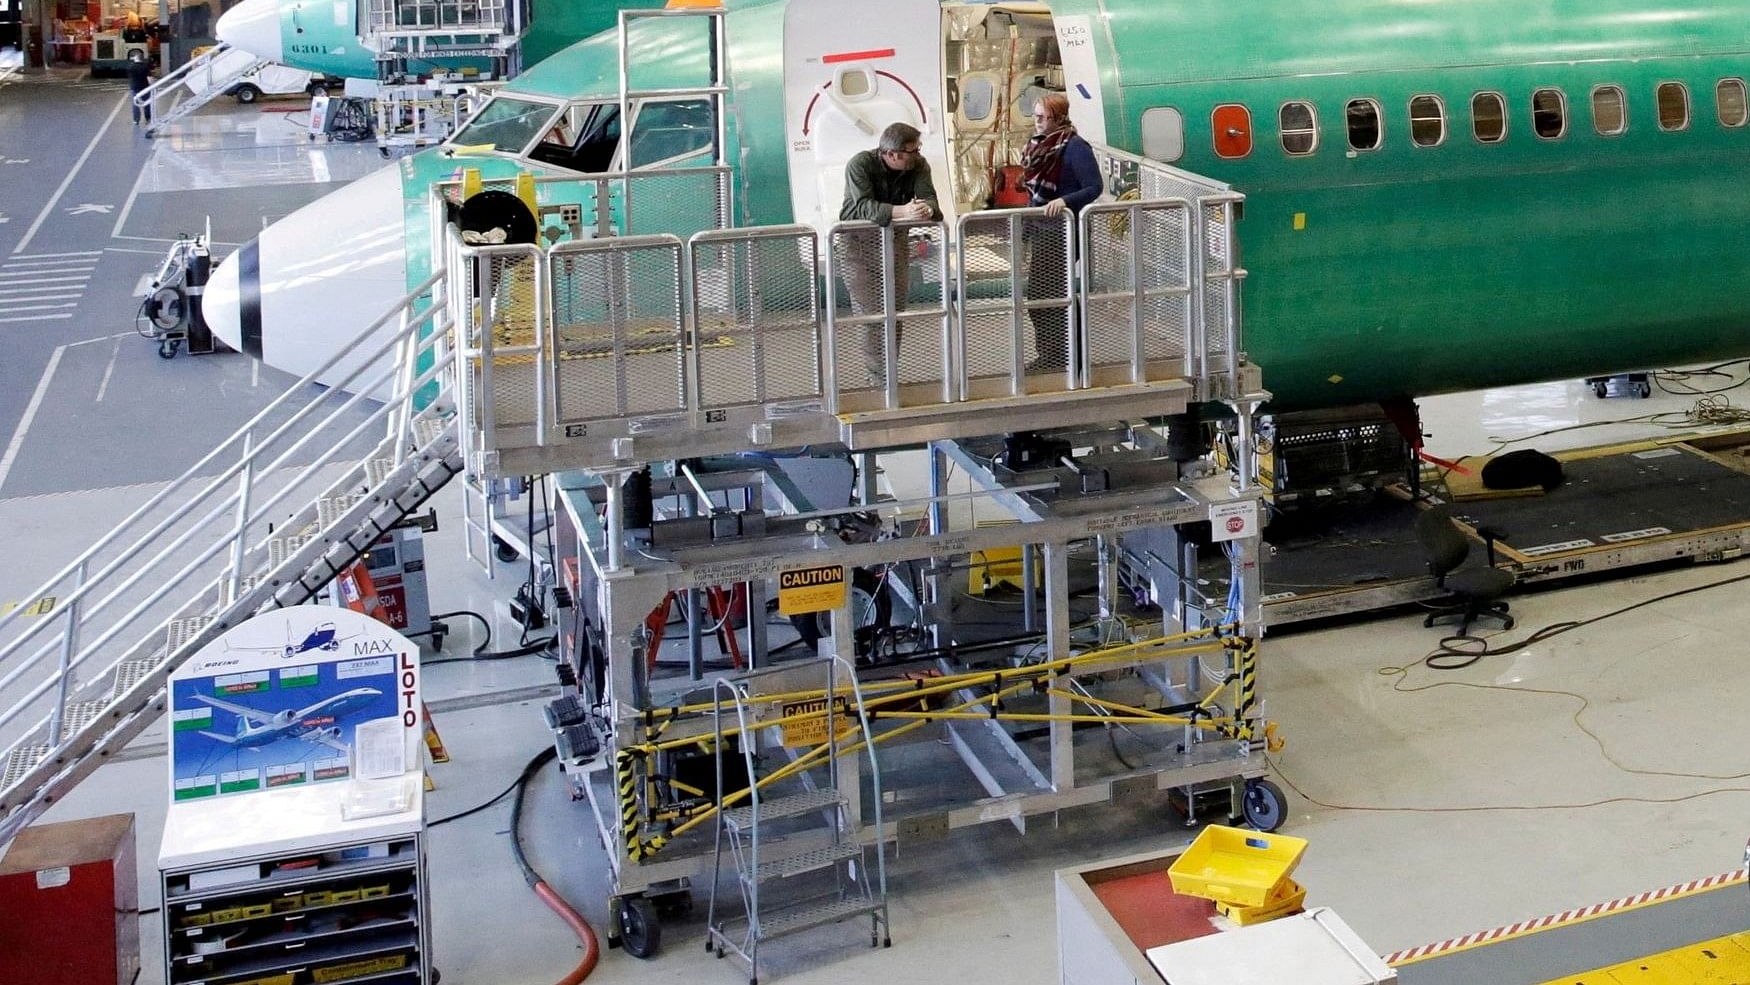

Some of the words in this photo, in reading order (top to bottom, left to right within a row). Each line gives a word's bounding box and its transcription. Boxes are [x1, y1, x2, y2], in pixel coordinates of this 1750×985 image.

[291, 44, 328, 54] 6301
[1226, 520, 1244, 530] STOP
[1564, 559, 1585, 572] FWD
[781, 567, 842, 587] CAUTION
[354, 638, 393, 656] MAX
[401, 652, 416, 727] LOTO
[785, 698, 845, 718] CAUTIN
